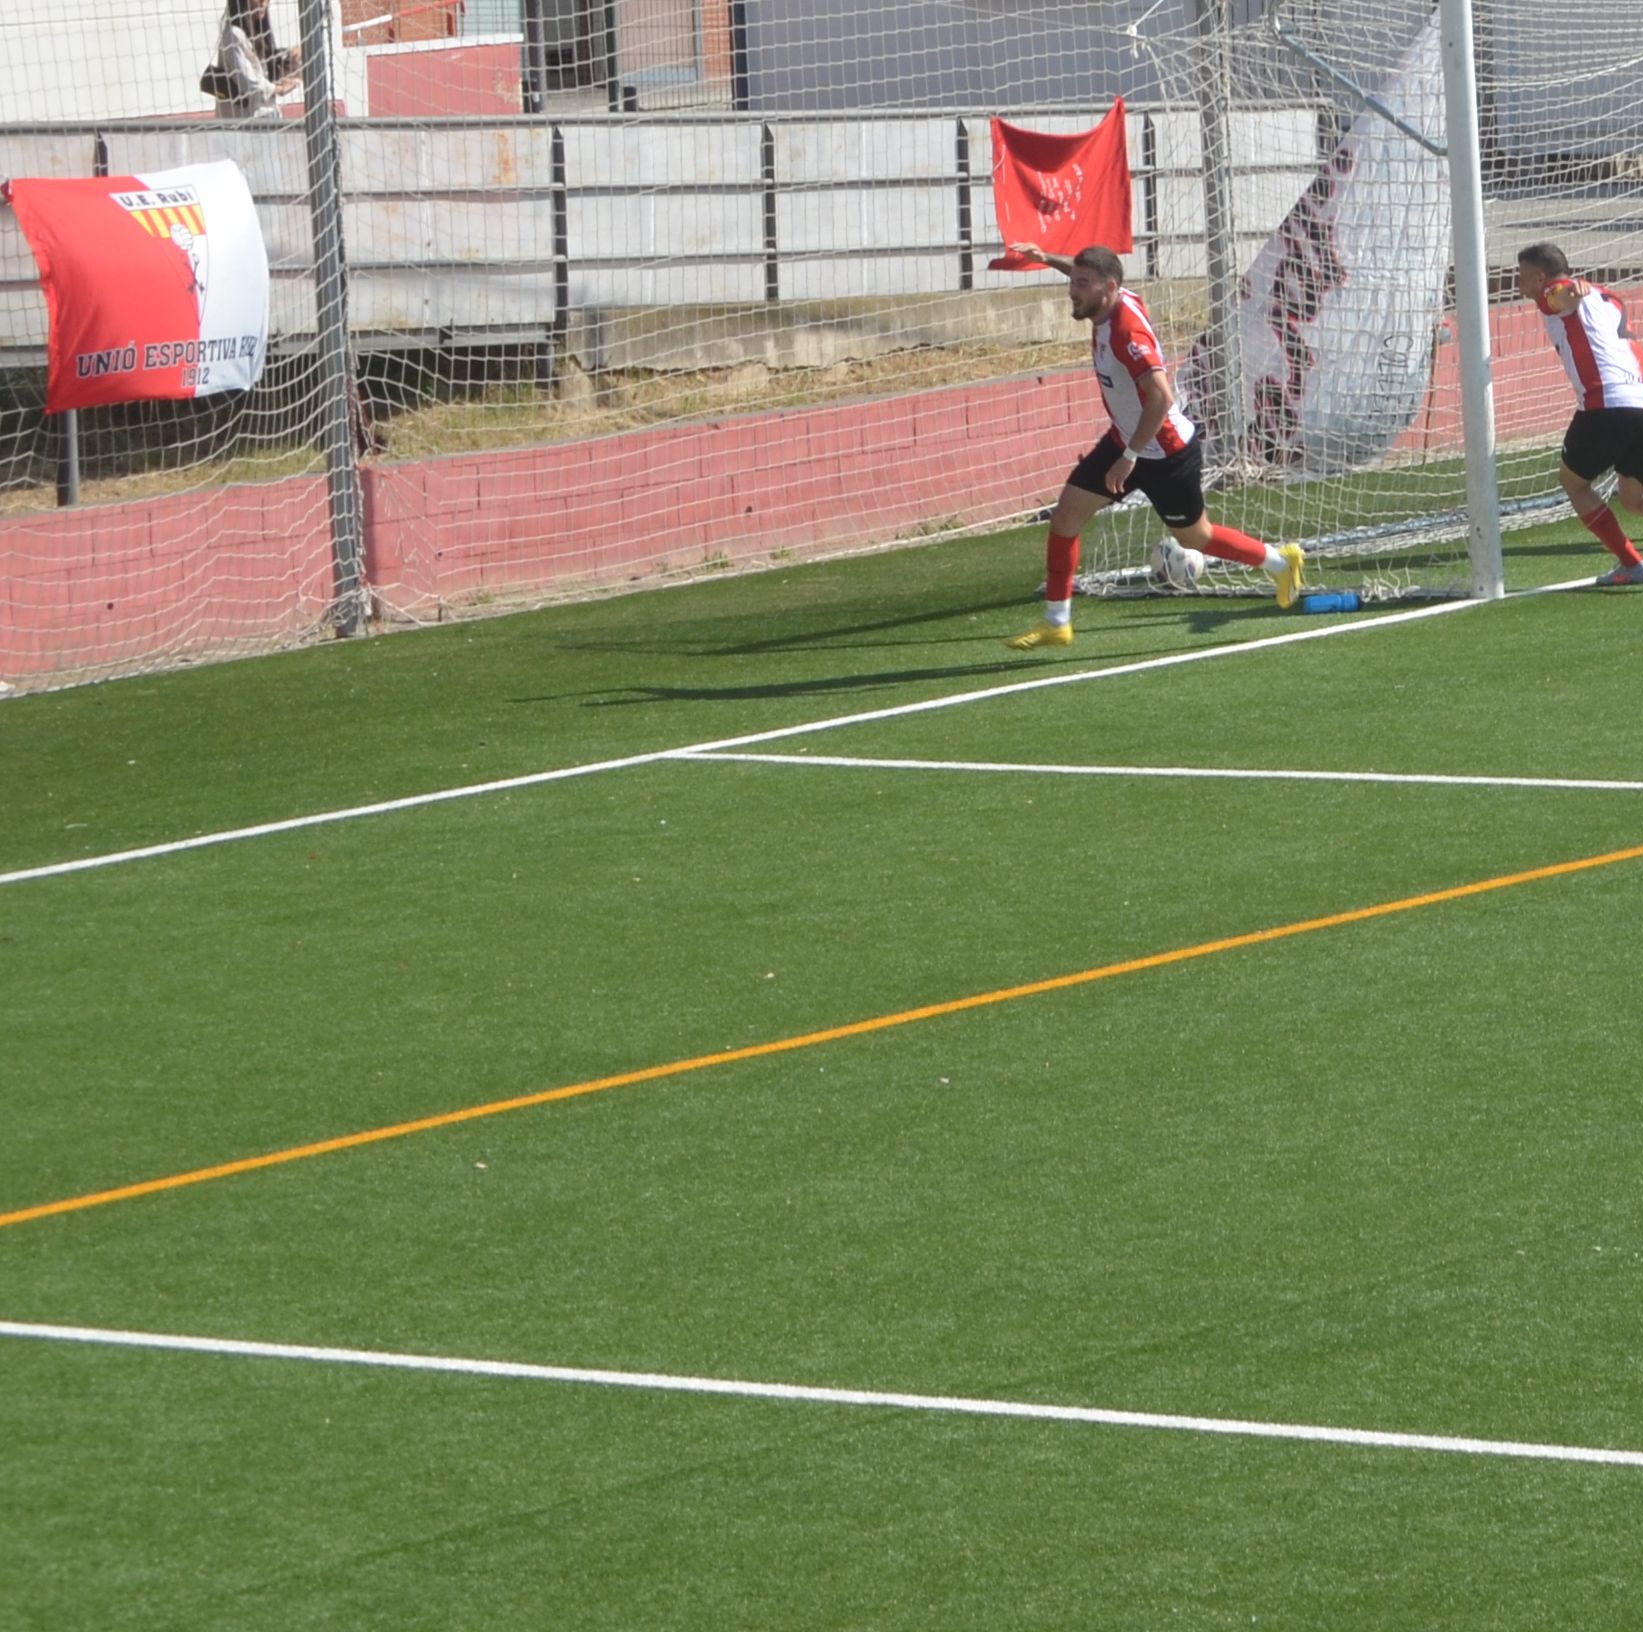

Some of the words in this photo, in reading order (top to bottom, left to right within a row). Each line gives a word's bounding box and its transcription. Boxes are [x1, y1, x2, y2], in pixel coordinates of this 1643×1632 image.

[76, 340, 138, 378] UNIÓ
[142, 337, 237, 369] ESPORTIVA
[180, 366, 210, 388] 1912
